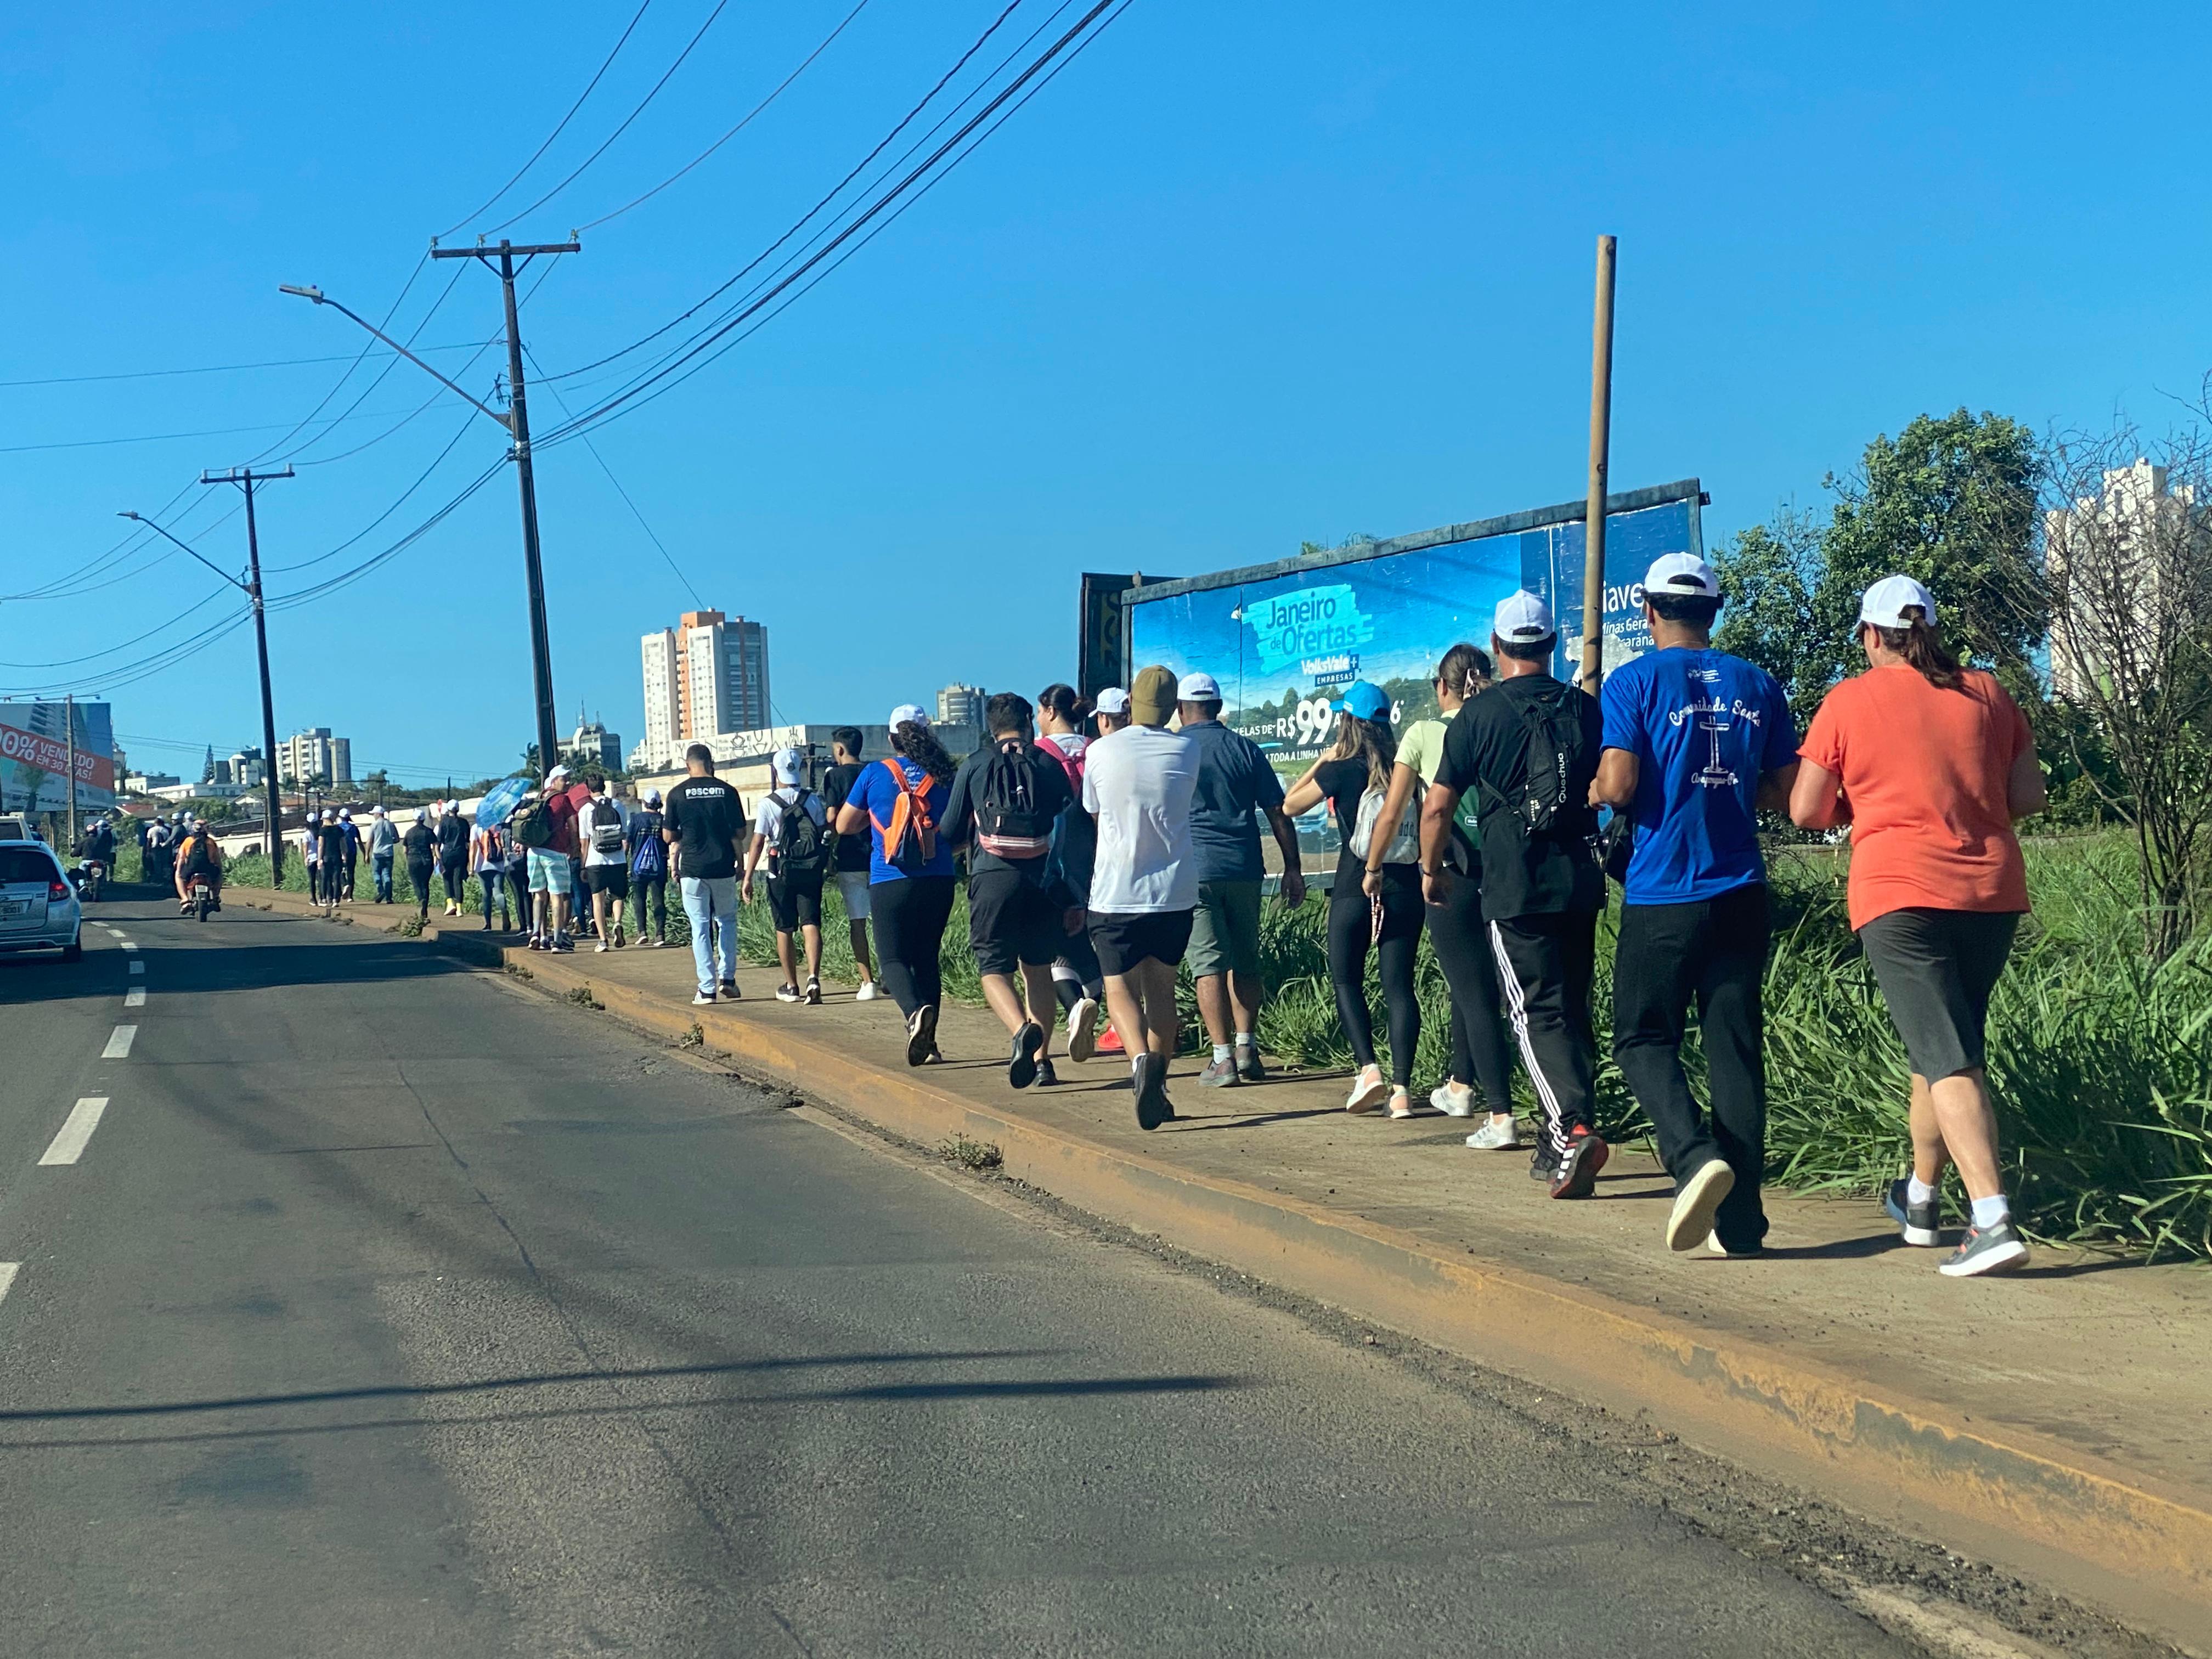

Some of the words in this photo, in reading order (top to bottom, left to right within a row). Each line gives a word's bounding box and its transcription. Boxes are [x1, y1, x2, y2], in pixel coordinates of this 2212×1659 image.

[1266, 591, 1336, 629] Janeiro
[1602, 580, 1644, 613] iave
[1270, 636, 1282, 650] de
[1282, 624, 1357, 656] Ofertas
[1626, 618, 1650, 631] Gera
[1317, 672, 1353, 685] EMPRESAS
[0, 728, 37, 761] 0%
[1270, 752, 1290, 763] TODA
[1296, 749, 1319, 761] LINHA
[36, 755, 49, 766] EM
[50, 759, 63, 770] 30
[1558, 753, 1567, 803] Quechua
